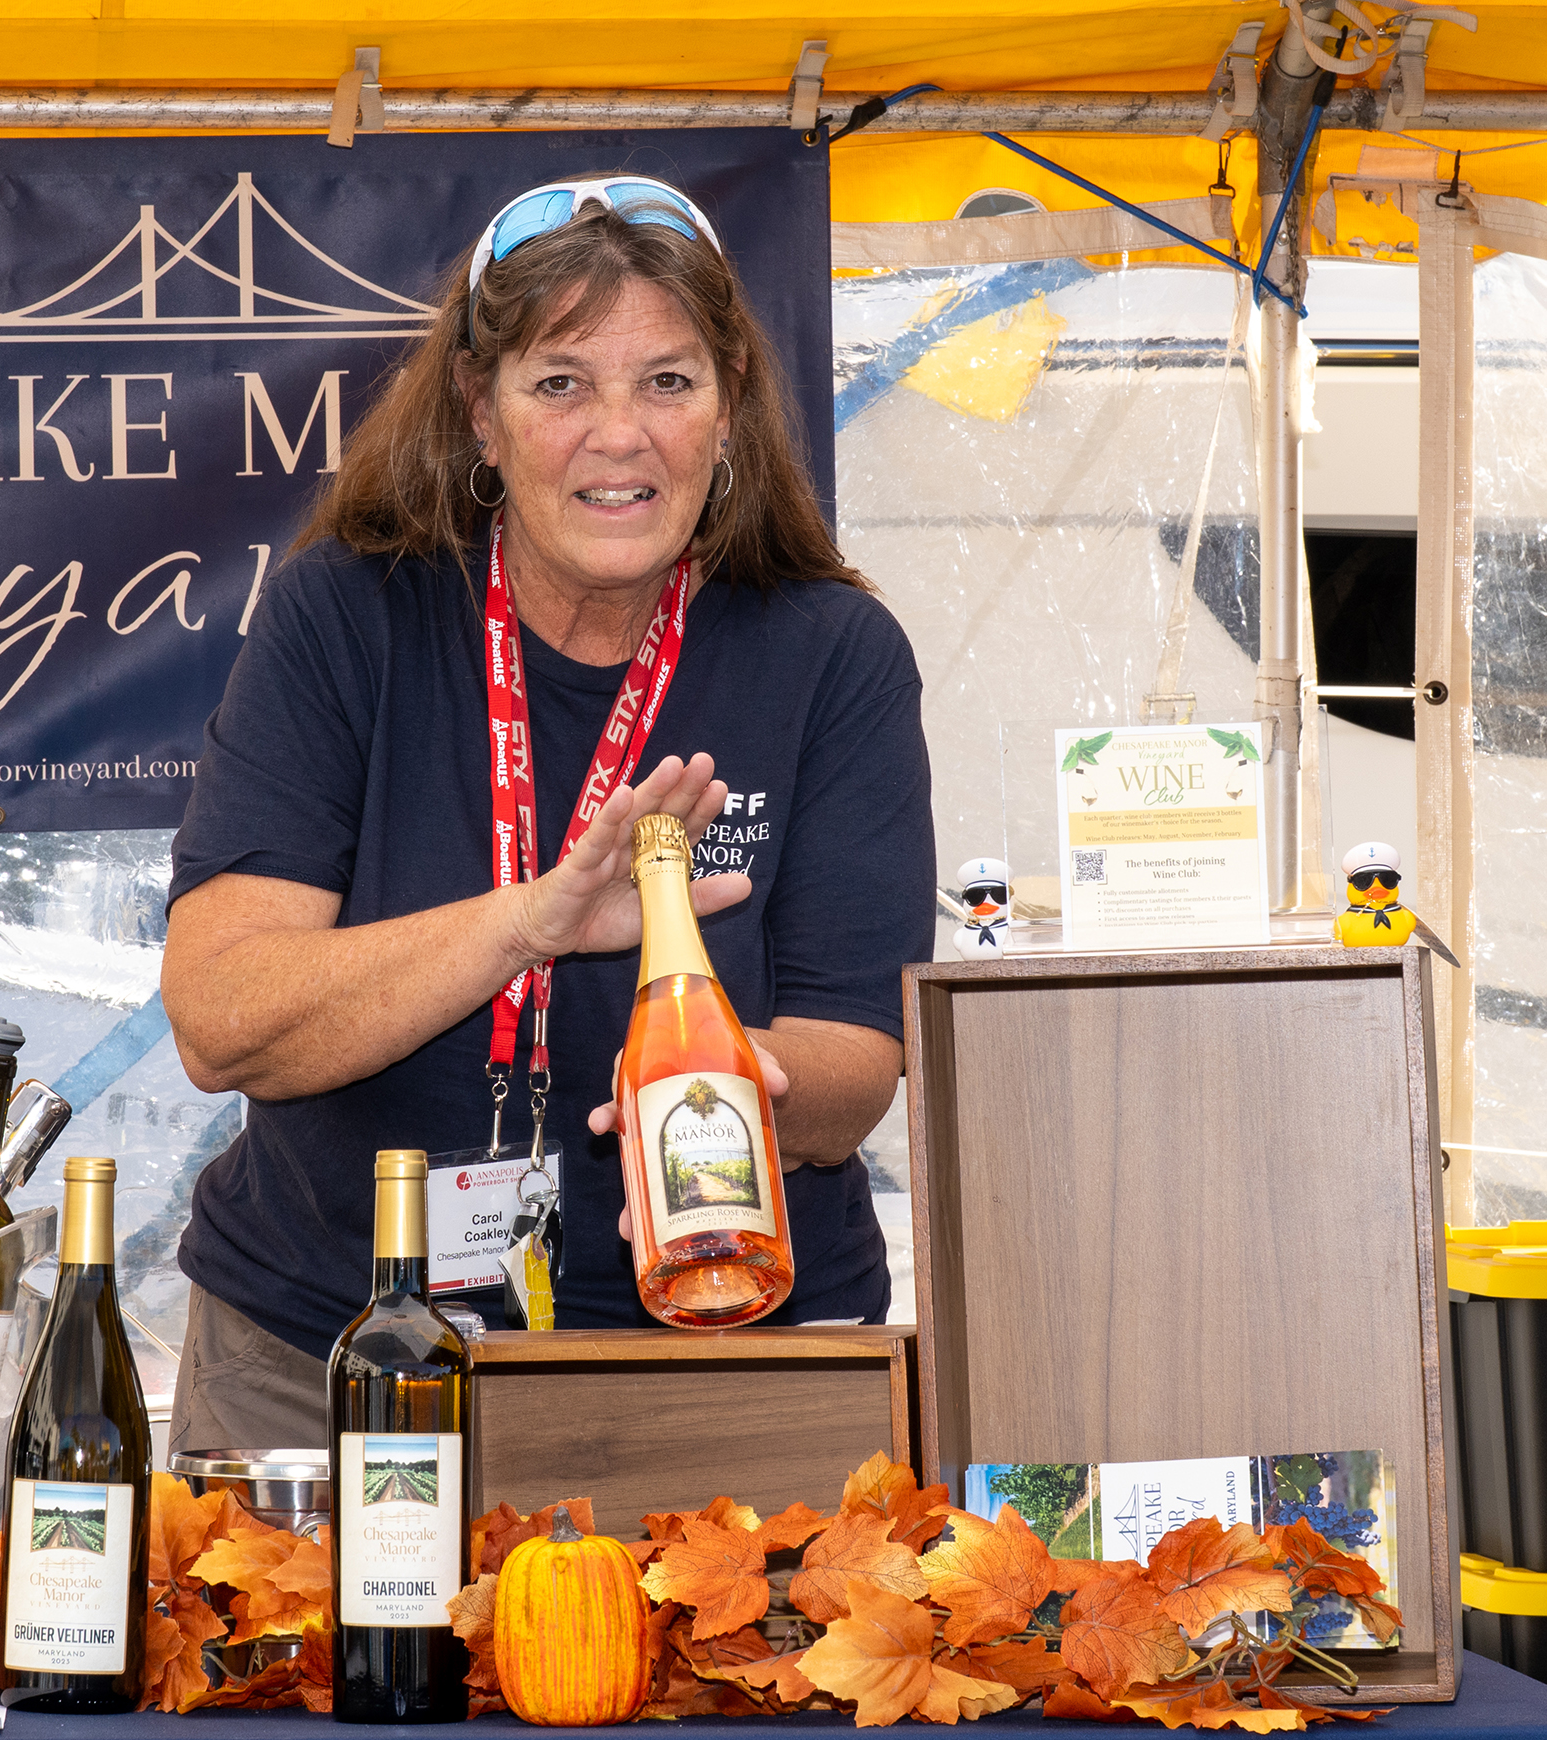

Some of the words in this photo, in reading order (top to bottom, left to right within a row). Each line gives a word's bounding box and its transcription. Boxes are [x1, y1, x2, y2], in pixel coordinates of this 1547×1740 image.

[636, 603, 670, 671] STX
[606, 679, 643, 748] STX
[1112, 740, 1171, 751] CHESAPEAKE
[1173, 739, 1208, 749] MANOR
[1138, 746, 1186, 764] Vineyard
[1116, 763, 1205, 792] WINE
[578, 758, 616, 823] STX
[1143, 786, 1185, 806] Club
[1153, 811, 1181, 819] members
[1215, 830, 1241, 838] February
[1125, 859, 1141, 868] The
[1144, 858, 1180, 867] benefits
[1182, 857, 1192, 867] of
[1193, 857, 1226, 868] joining
[1152, 870, 1176, 879] Wine
[1178, 869, 1201, 878] Club:
[1119, 888, 1157, 896] customizable
[675, 1123, 733, 1133] CHESAPEAKE
[675, 1127, 737, 1143] MANOR
[476, 1166, 524, 1180] ANNAPOLIS
[473, 1178, 509, 1188] POWERBOAT
[472, 1211, 502, 1225] Carol
[667, 1209, 715, 1227] SPARKLING
[741, 1208, 765, 1221] WINE
[464, 1227, 510, 1243] Coakley
[437, 1248, 481, 1262] Chesapeake
[482, 1246, 505, 1256] Manor
[468, 1274, 505, 1286] EXHIBIT
[363, 1526, 437, 1546] Chesapeake
[379, 1542, 422, 1555] Manor
[364, 1555, 437, 1563] VINEYARD
[29, 1572, 103, 1592] Chesapeake
[363, 1580, 437, 1597] CHARDONEL
[43, 1588, 86, 1602] Manor
[30, 1600, 101, 1611] VINEYARD
[14, 1622, 55, 1642] GRÜNER
[57, 1627, 115, 1645] VELTLINER
[38, 1649, 86, 1658] MARYLAND
